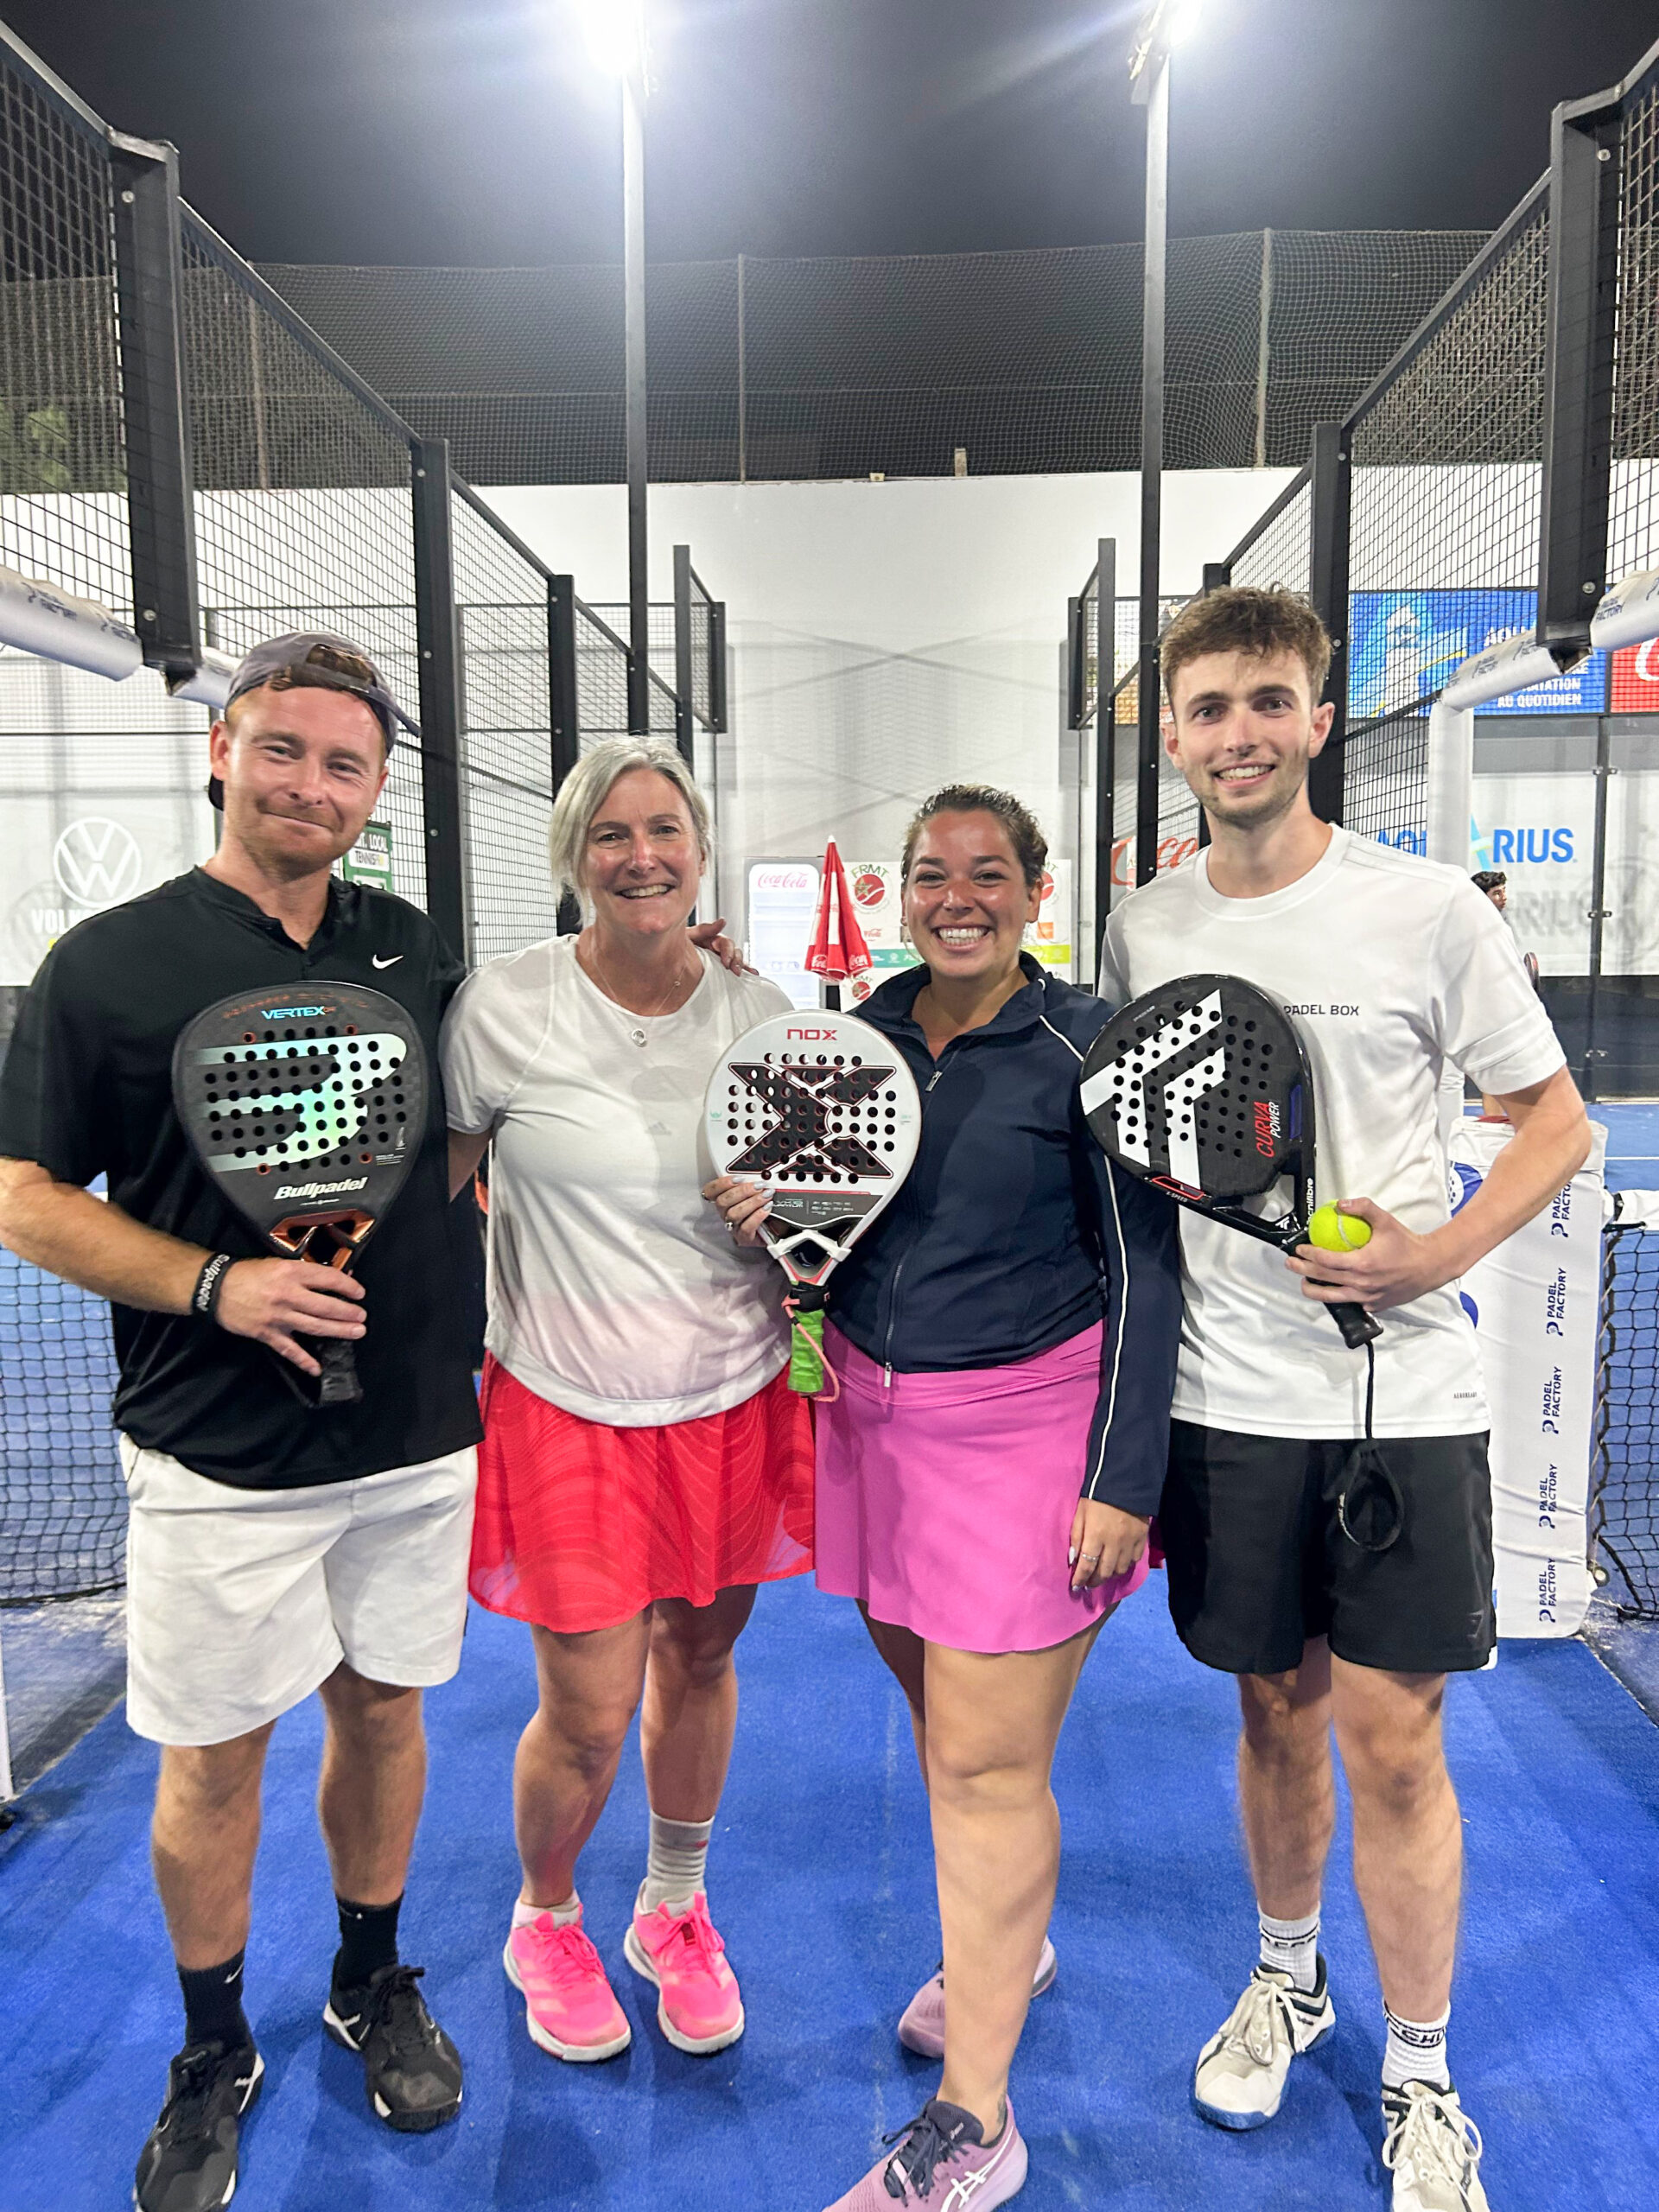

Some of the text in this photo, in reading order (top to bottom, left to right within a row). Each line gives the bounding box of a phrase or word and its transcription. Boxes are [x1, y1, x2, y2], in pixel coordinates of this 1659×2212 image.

[1497, 694, 1582, 708] AU QUOTIDIEN
[851, 864, 890, 879] FRMT
[261, 1006, 326, 1020] VERTEX
[1284, 1004, 1360, 1016] PADEL BOX
[1254, 1101, 1275, 1157] CURVA
[1268, 1102, 1281, 1139] POWER
[273, 1176, 369, 1200] Bullpadel
[1552, 1190, 1561, 1219] PAD
[1561, 1181, 1573, 1220] FACTO
[1547, 1281, 1557, 1318] PADEL
[1556, 1268, 1567, 1319] FACTORY
[1542, 1381, 1553, 1416] PADEL
[1552, 1366, 1562, 1418] FACTORY
[1539, 1477, 1548, 1511] PADEL
[1548, 1464, 1558, 1513] FACTORY
[1539, 1570, 1548, 1605] PADEL
[1548, 1557, 1556, 1607] FACTORY
